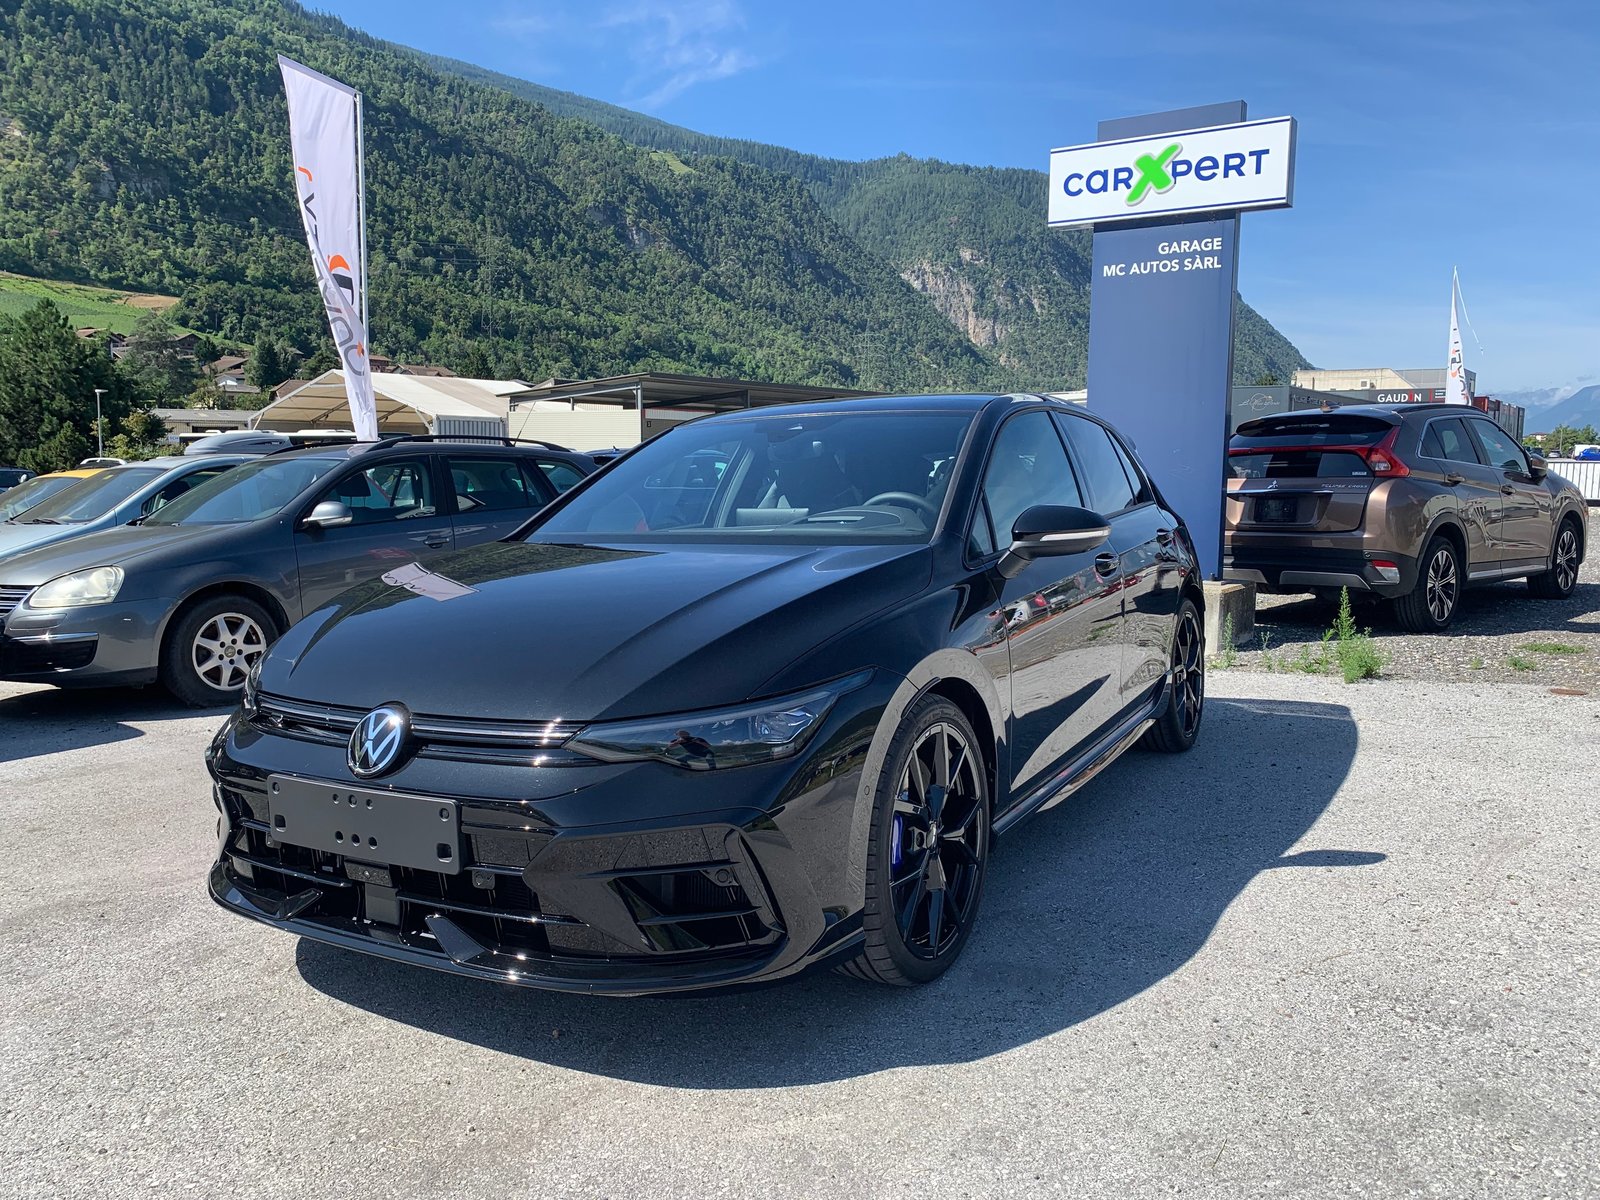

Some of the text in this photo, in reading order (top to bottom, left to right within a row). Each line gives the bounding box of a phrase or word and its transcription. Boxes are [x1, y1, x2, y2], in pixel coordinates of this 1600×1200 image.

[1158, 237, 1222, 255] GARAGE
[1103, 254, 1222, 277] MC AUTOS SÀRL
[1377, 391, 1422, 403] GAUDIN
